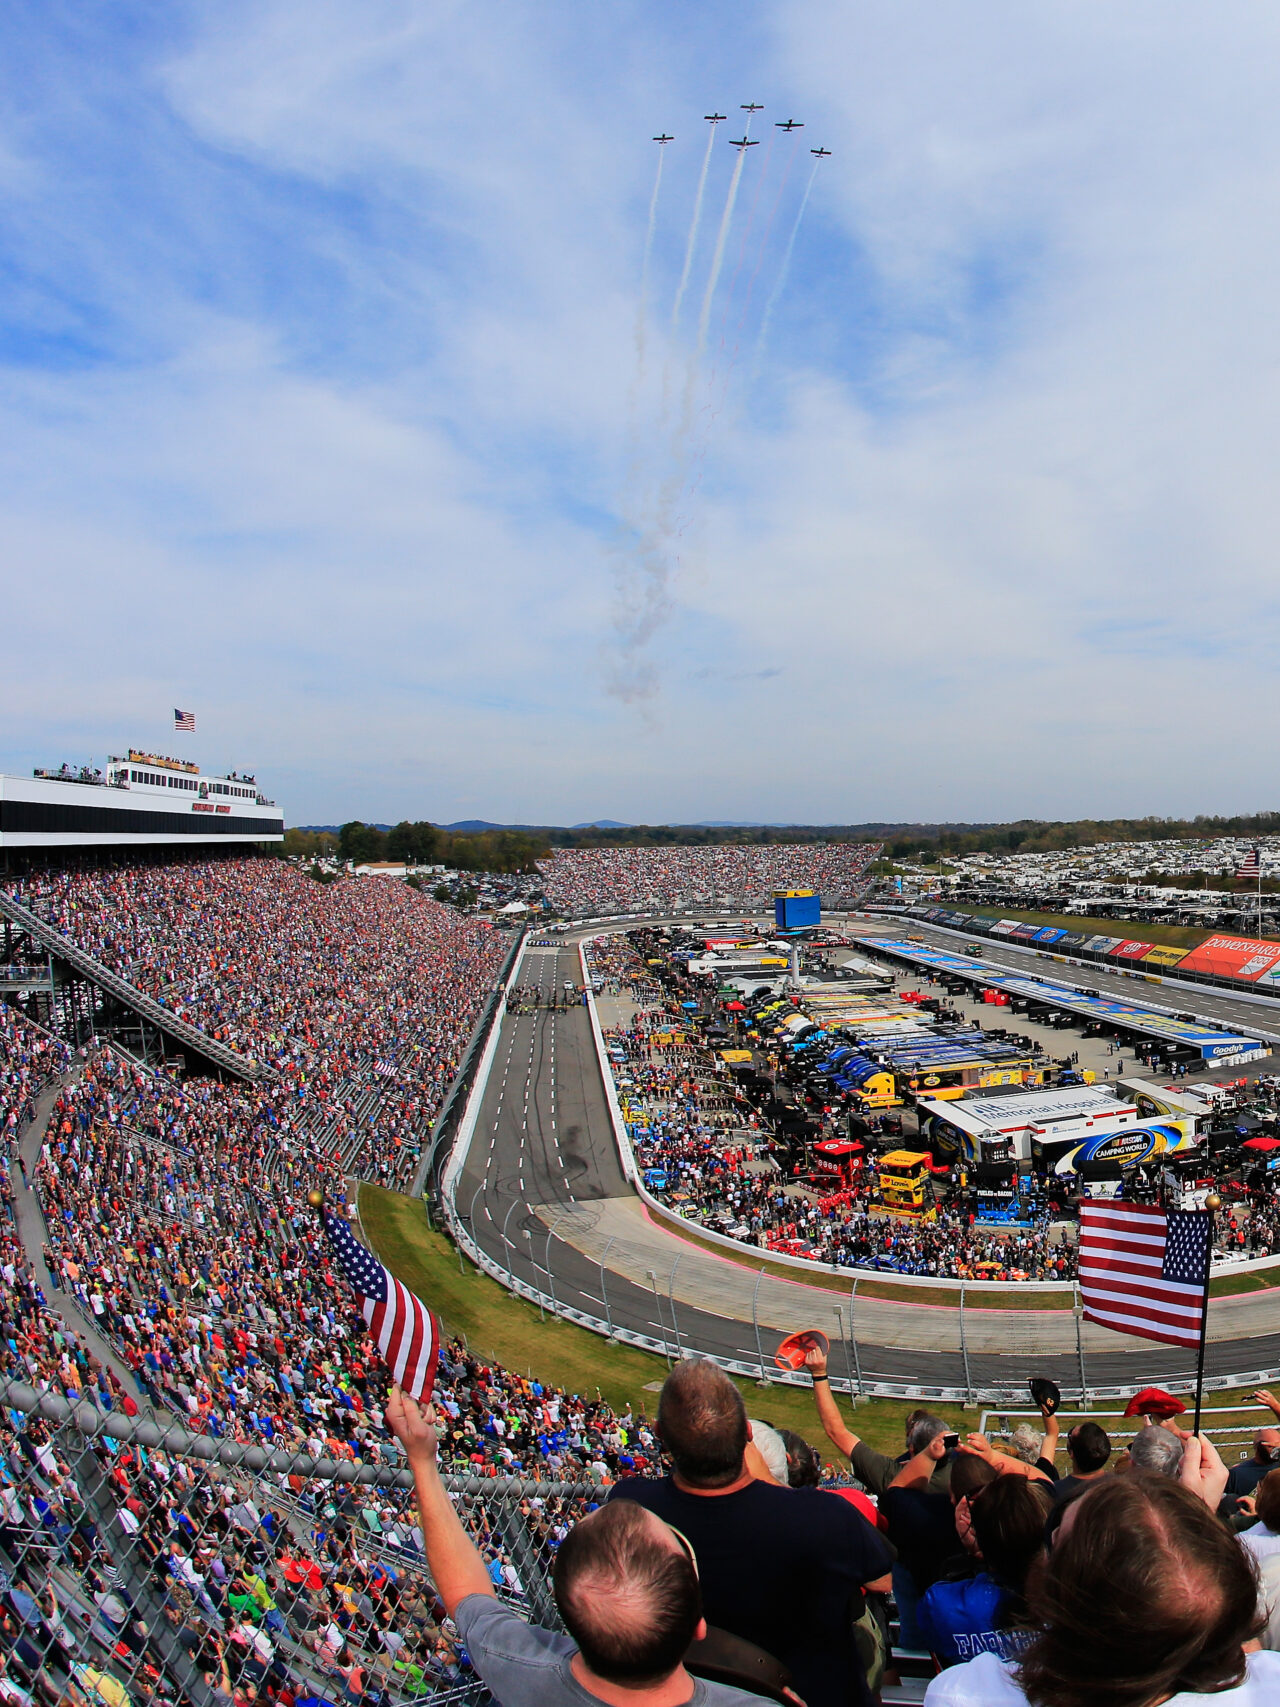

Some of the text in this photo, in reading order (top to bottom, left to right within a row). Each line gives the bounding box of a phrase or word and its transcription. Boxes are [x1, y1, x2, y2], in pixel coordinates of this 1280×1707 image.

[1213, 1044, 1244, 1056] Goody's
[983, 1104, 1055, 1120] Memorial
[1053, 1097, 1115, 1112] Hospital
[1095, 1142, 1149, 1158] CAMPING WORLD
[1184, 1180, 1196, 1190] 21
